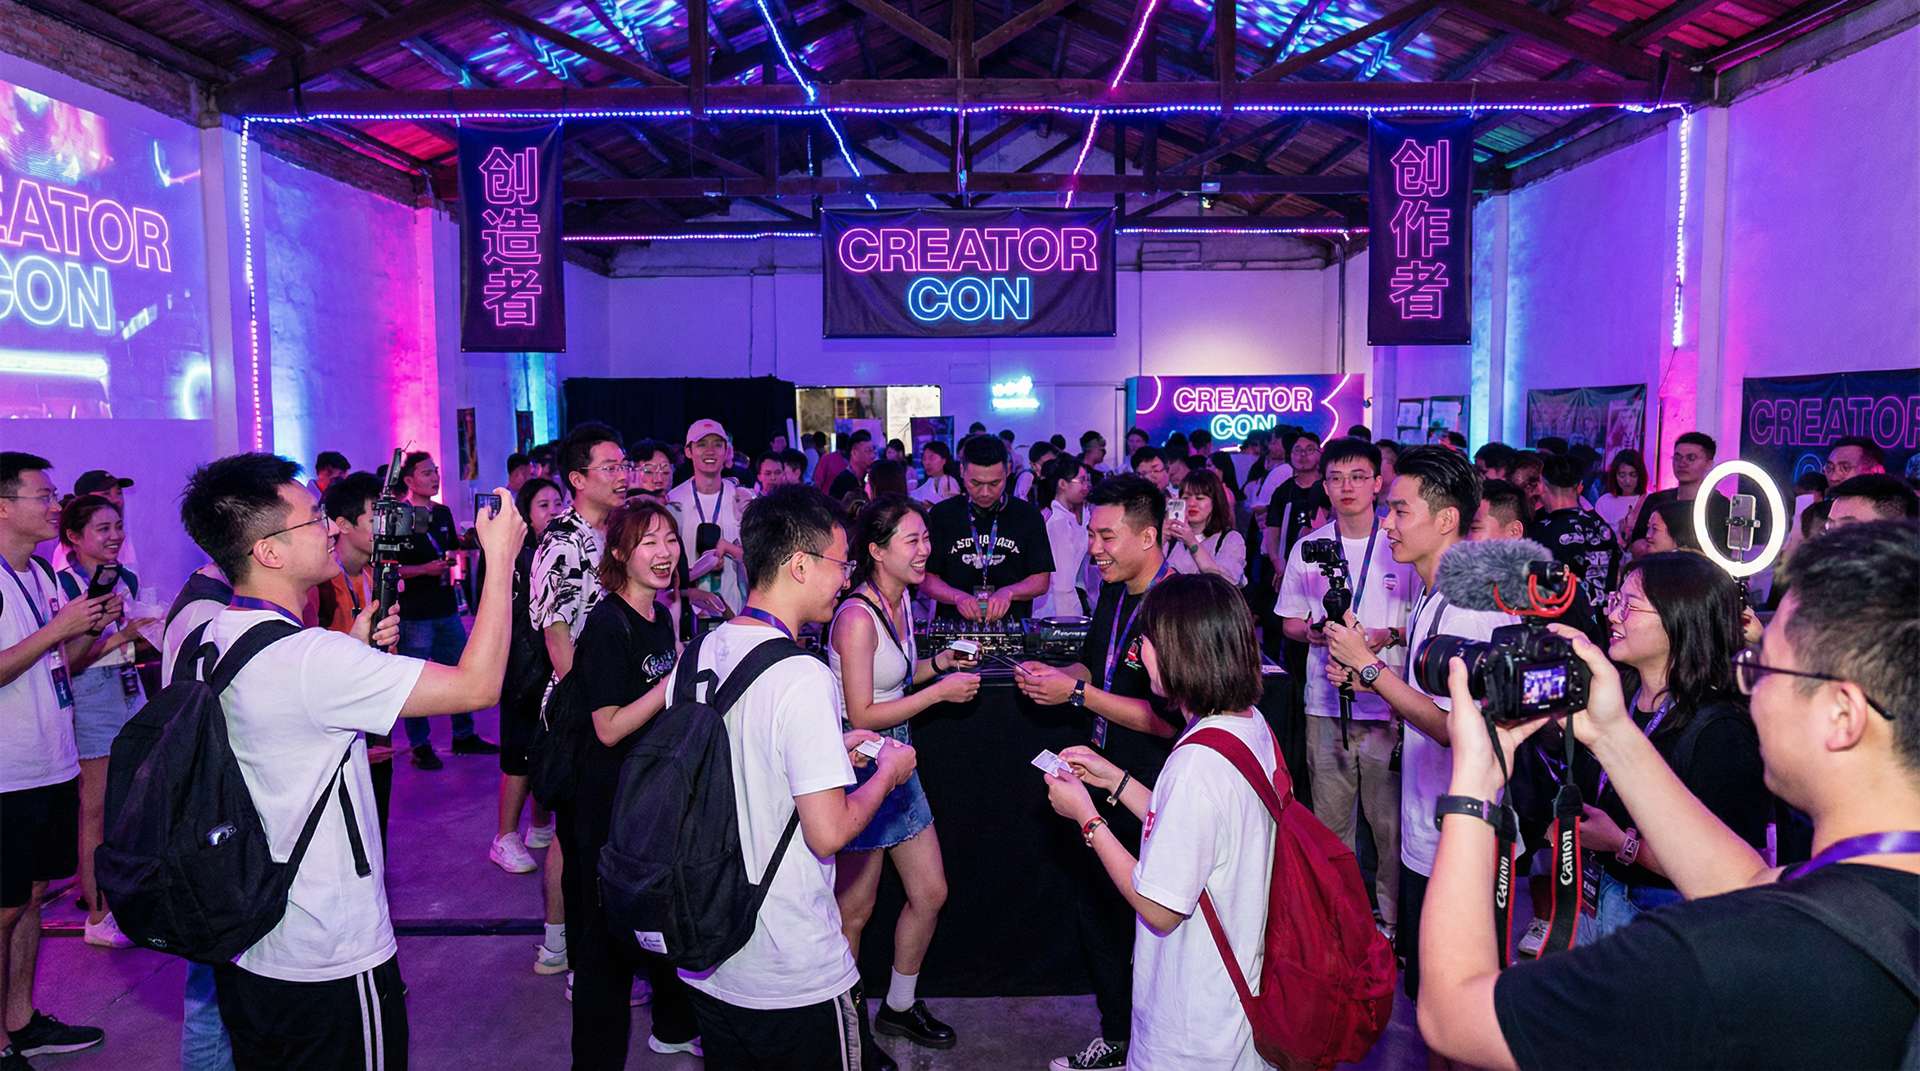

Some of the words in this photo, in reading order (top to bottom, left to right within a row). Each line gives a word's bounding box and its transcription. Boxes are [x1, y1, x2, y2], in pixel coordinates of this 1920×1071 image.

[0, 175, 172, 273] ATOR
[479, 146, 542, 327] 创造者
[838, 227, 1098, 273] CREATOR
[1389, 139, 1450, 320] 创作者
[908, 277, 1029, 321] CON
[1173, 386, 1313, 413] CREATOR
[1496, 855, 1510, 909] Canon
[1560, 829, 1573, 886] Canon
